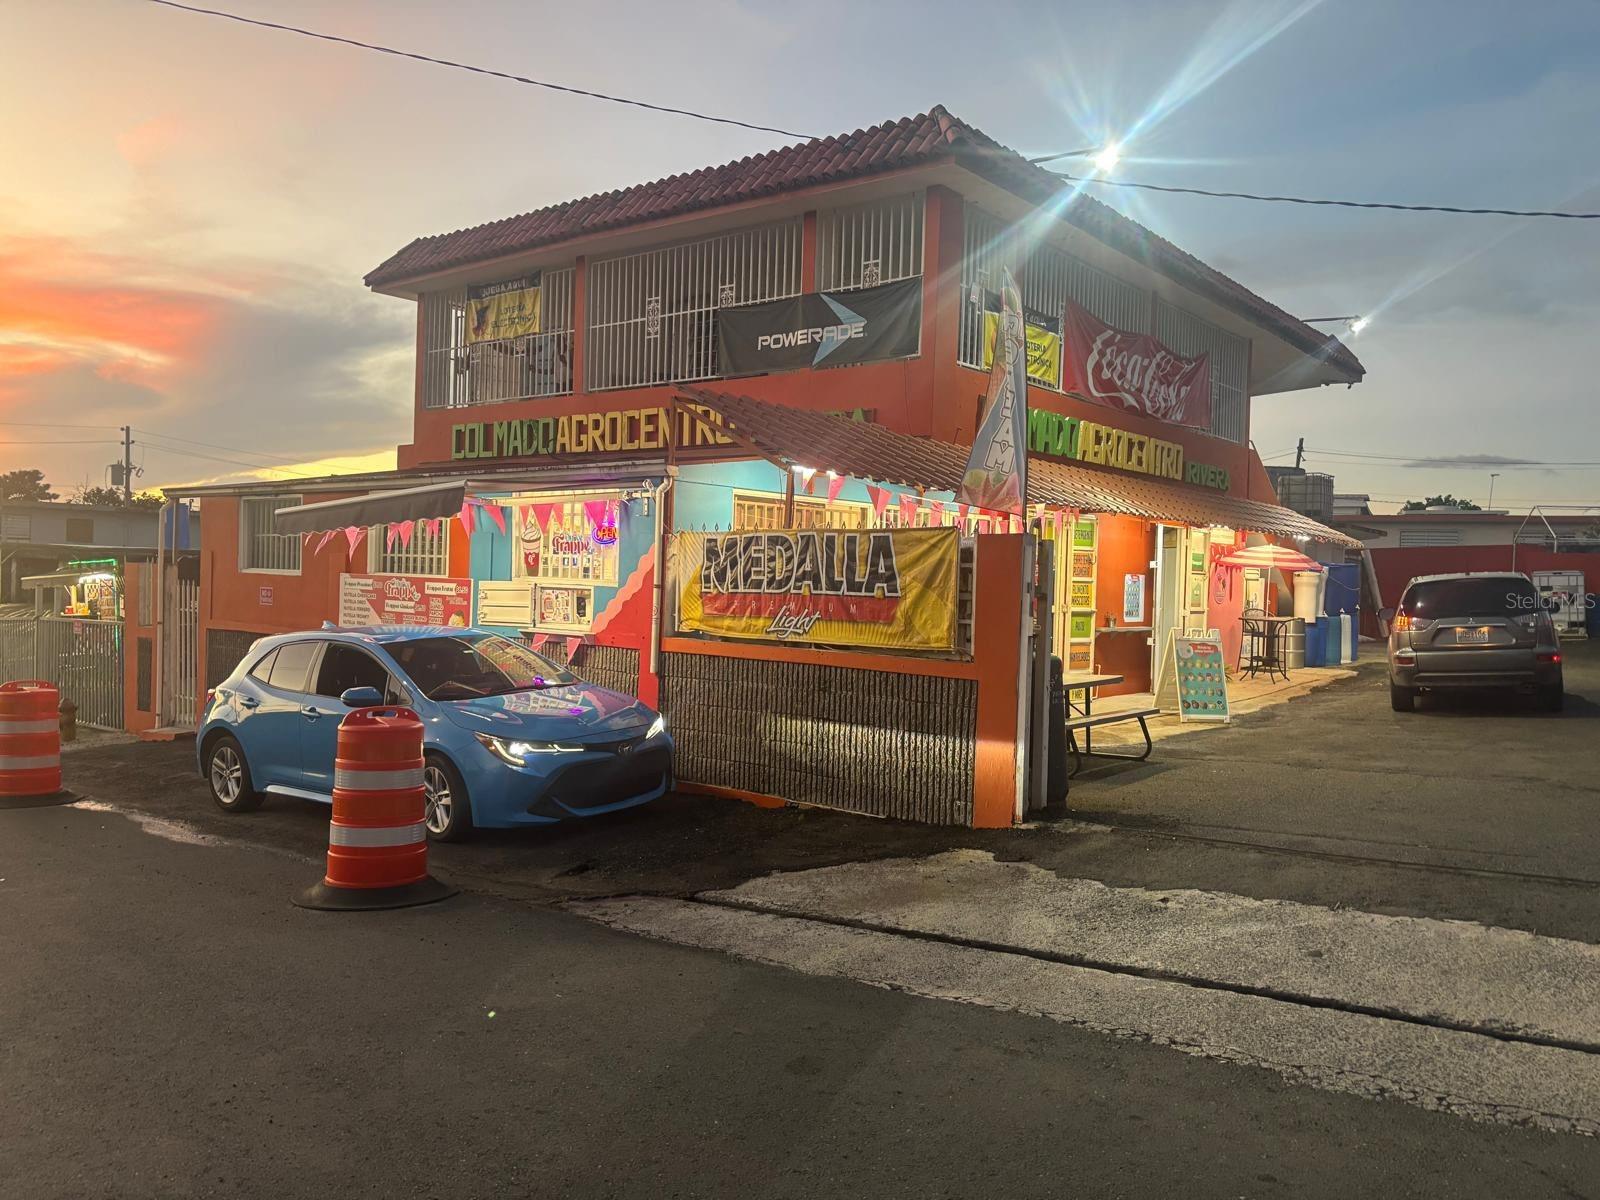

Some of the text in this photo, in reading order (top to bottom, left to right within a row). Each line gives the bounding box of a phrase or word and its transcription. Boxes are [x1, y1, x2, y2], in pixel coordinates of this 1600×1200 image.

[757, 322, 864, 351] POWERADE
[451, 416, 555, 459] COLMADO
[1185, 461, 1232, 491] RIVERA
[701, 531, 901, 597] MEDALLA
[766, 605, 822, 639] Light
